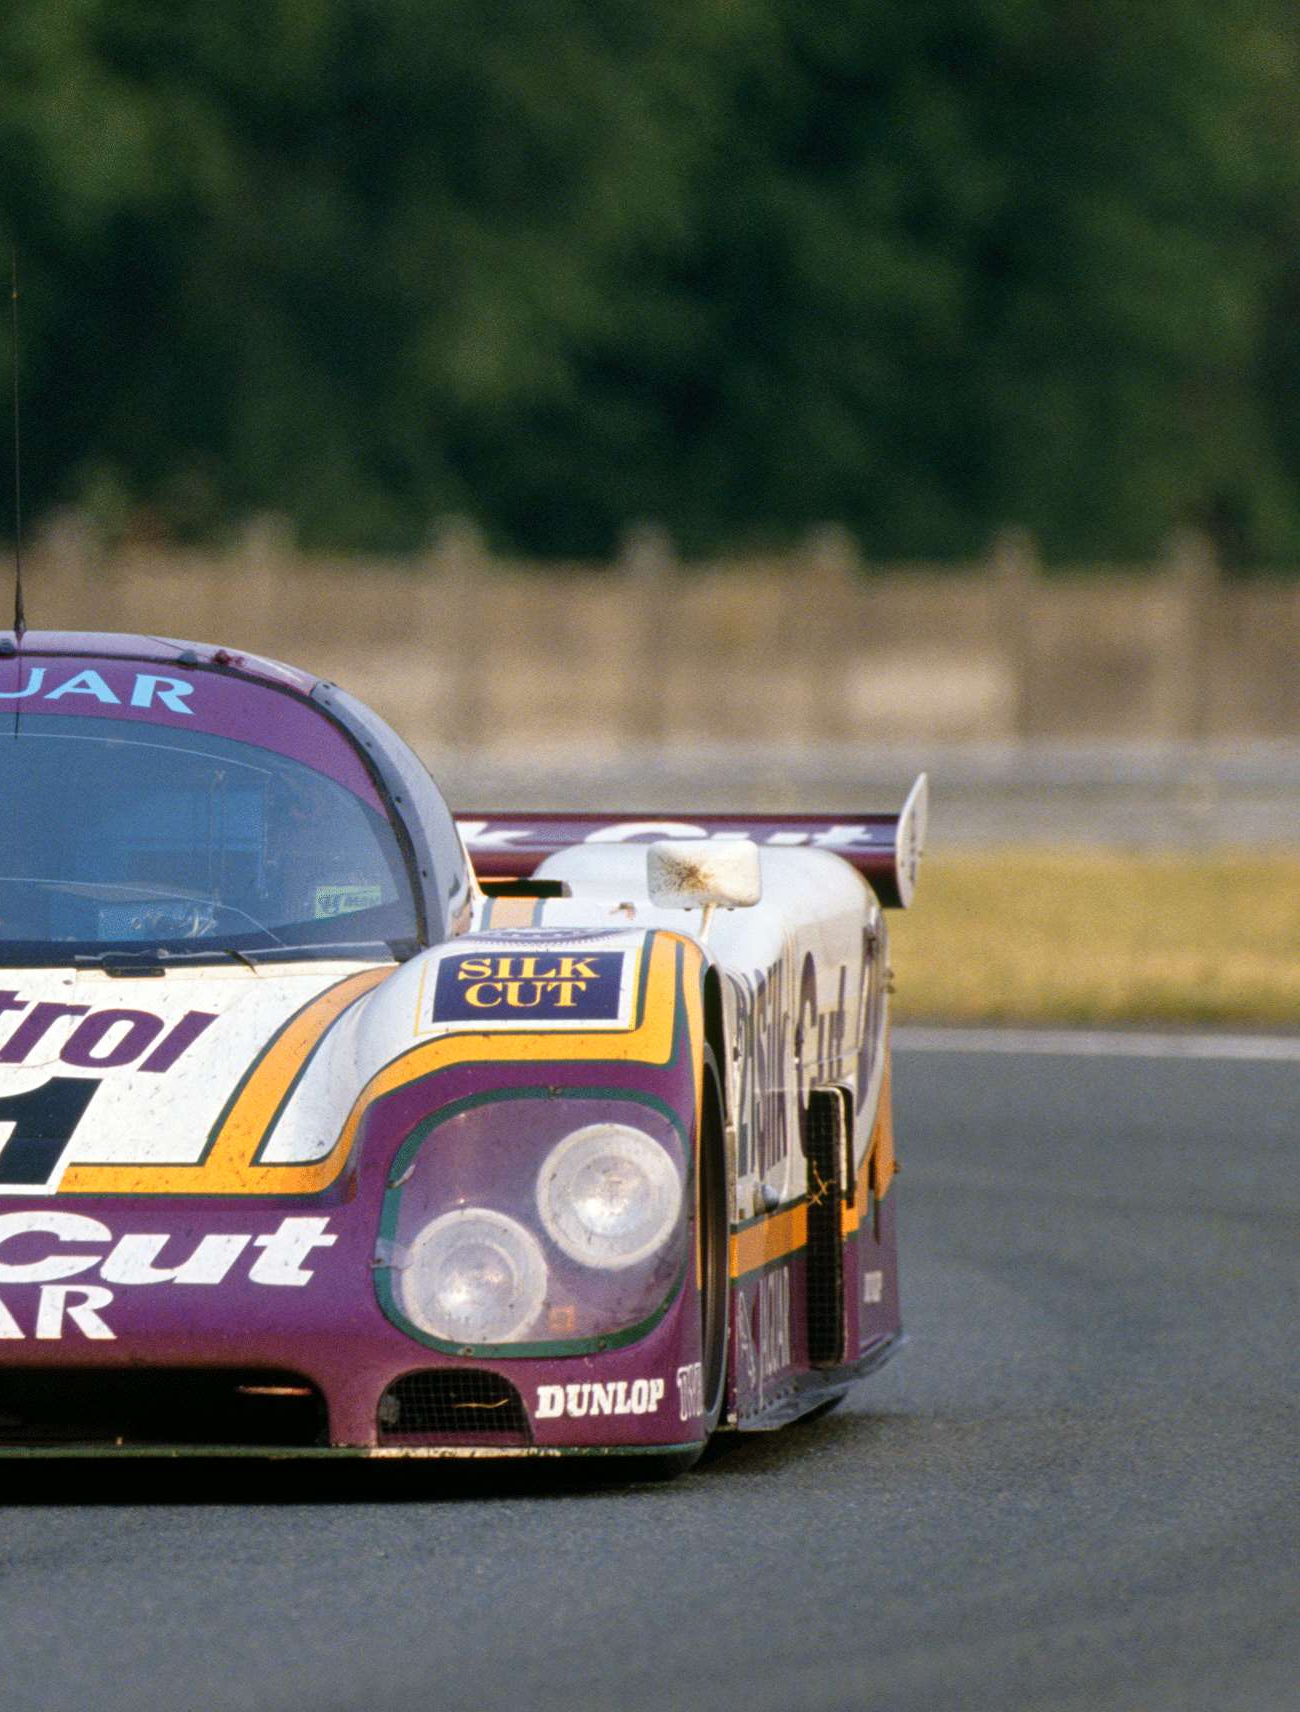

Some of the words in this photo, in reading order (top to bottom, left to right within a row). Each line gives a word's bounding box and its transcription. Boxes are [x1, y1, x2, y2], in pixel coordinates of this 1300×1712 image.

[458, 957, 601, 981] SILK
[464, 980, 588, 1008] CUT
[535, 1378, 665, 1420] DUNLOP
